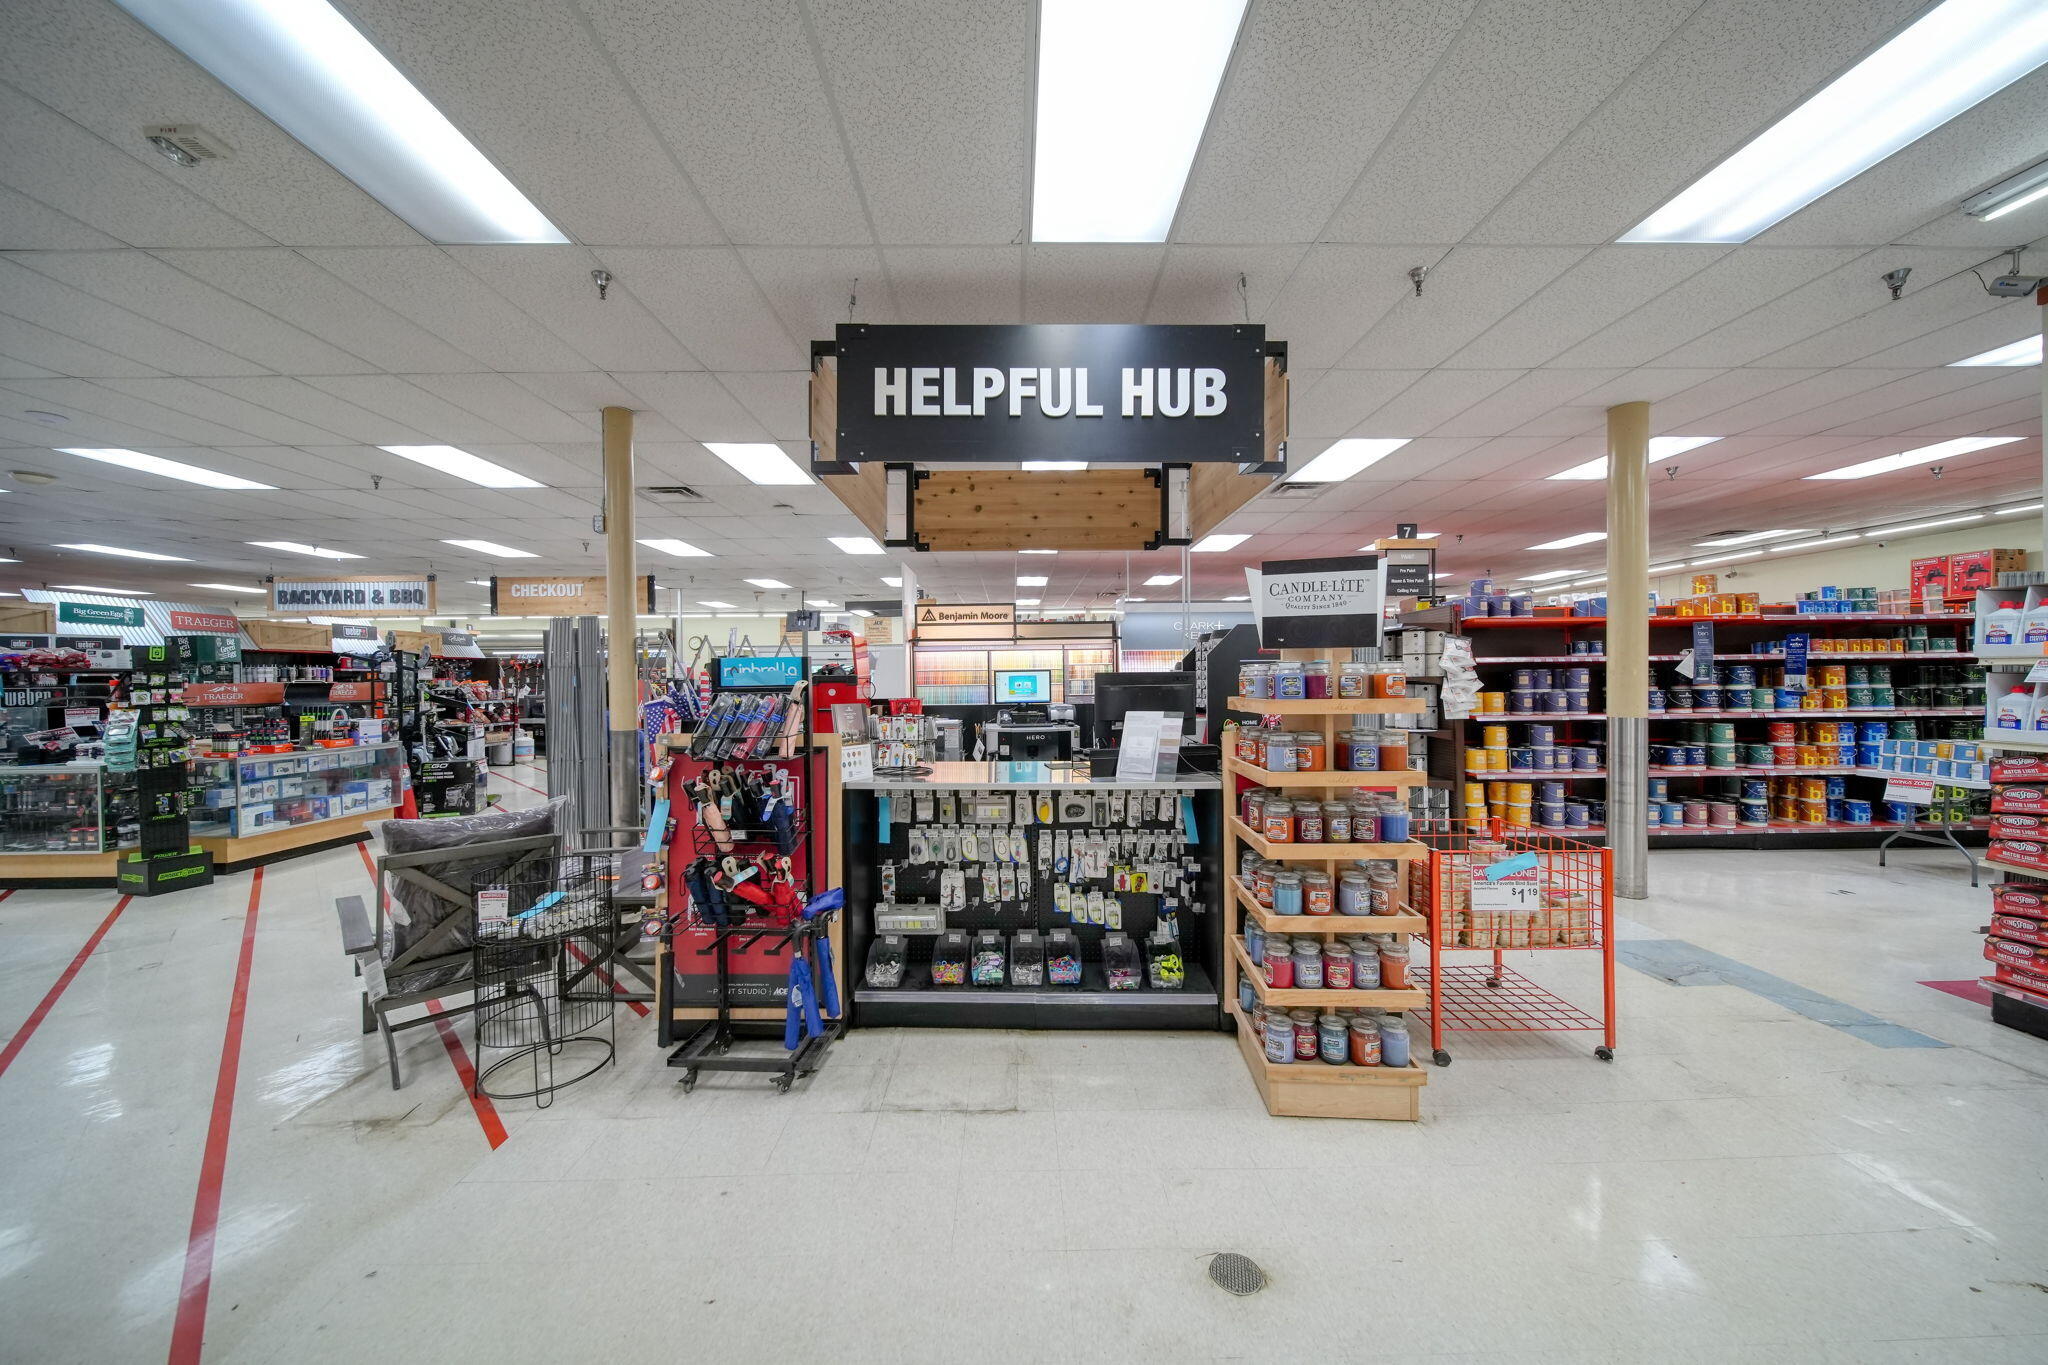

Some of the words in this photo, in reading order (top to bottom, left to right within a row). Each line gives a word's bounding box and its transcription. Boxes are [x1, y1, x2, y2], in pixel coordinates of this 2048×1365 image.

[874, 367, 1104, 418] HELPFUL
[1121, 367, 1228, 418] HUB
[1403, 527, 1411, 538] 7
[511, 583, 584, 598] CHECKOUT
[278, 589, 366, 605] BACKYARD
[372, 589, 384, 605] &
[390, 588, 424, 605] BBQ
[1287, 594, 1344, 603] COMPANY
[1332, 600, 1347, 608] 1840
[110, 610, 123, 618] Egg
[938, 612, 979, 621] Benjamin
[980, 612, 1009, 620] Moore
[175, 615, 234, 629] TRAEGER
[5, 688, 52, 706] weber
[2006, 791, 2039, 799] KINGSFORD
[2002, 818, 2035, 826] KINGSFORD
[2008, 841, 2038, 852] KINGSFORD
[2005, 895, 2036, 904] KINGSFORD
[2003, 920, 2034, 930] KINGSFORD
[1999, 943, 2030, 956] KINGSFORD
[773, 987, 789, 996] ACE
